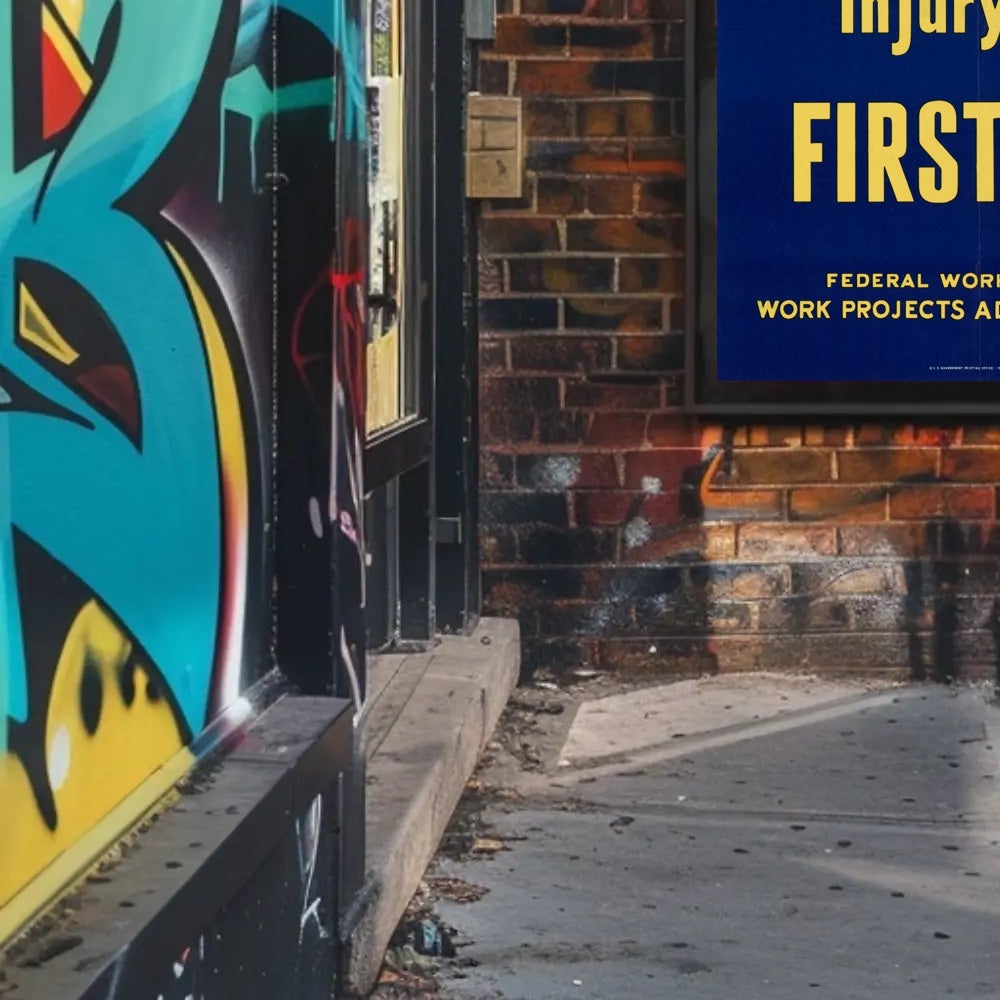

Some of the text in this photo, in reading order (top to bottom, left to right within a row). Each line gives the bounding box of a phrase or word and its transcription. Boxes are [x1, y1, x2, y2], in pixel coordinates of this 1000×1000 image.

[826, 273, 929, 288] FEDERAL
[756, 299, 832, 320] WORK
[842, 299, 965, 320] PROJECTS
